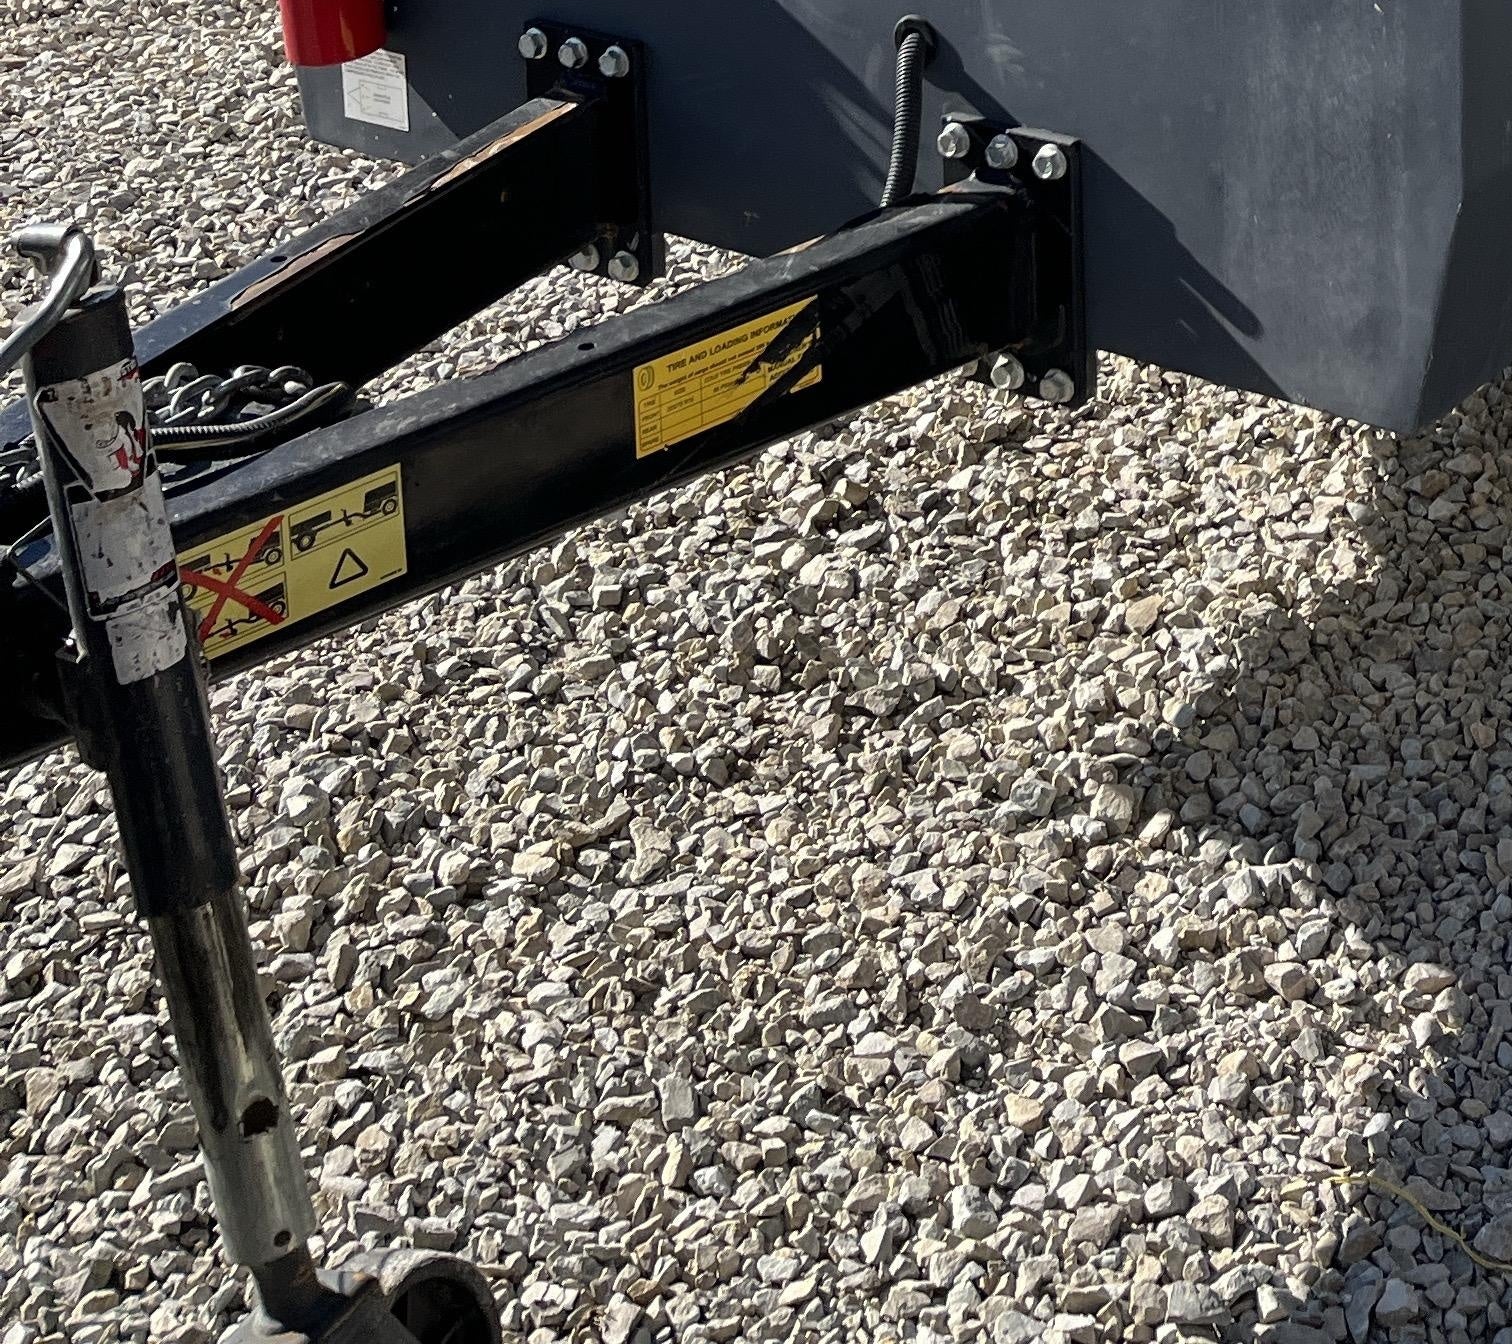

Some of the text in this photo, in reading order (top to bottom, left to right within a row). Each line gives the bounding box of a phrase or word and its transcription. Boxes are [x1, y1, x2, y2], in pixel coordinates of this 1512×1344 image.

[666, 358, 687, 373] TIRE
[688, 351, 708, 367] AND
[709, 334, 748, 356] LOADING
